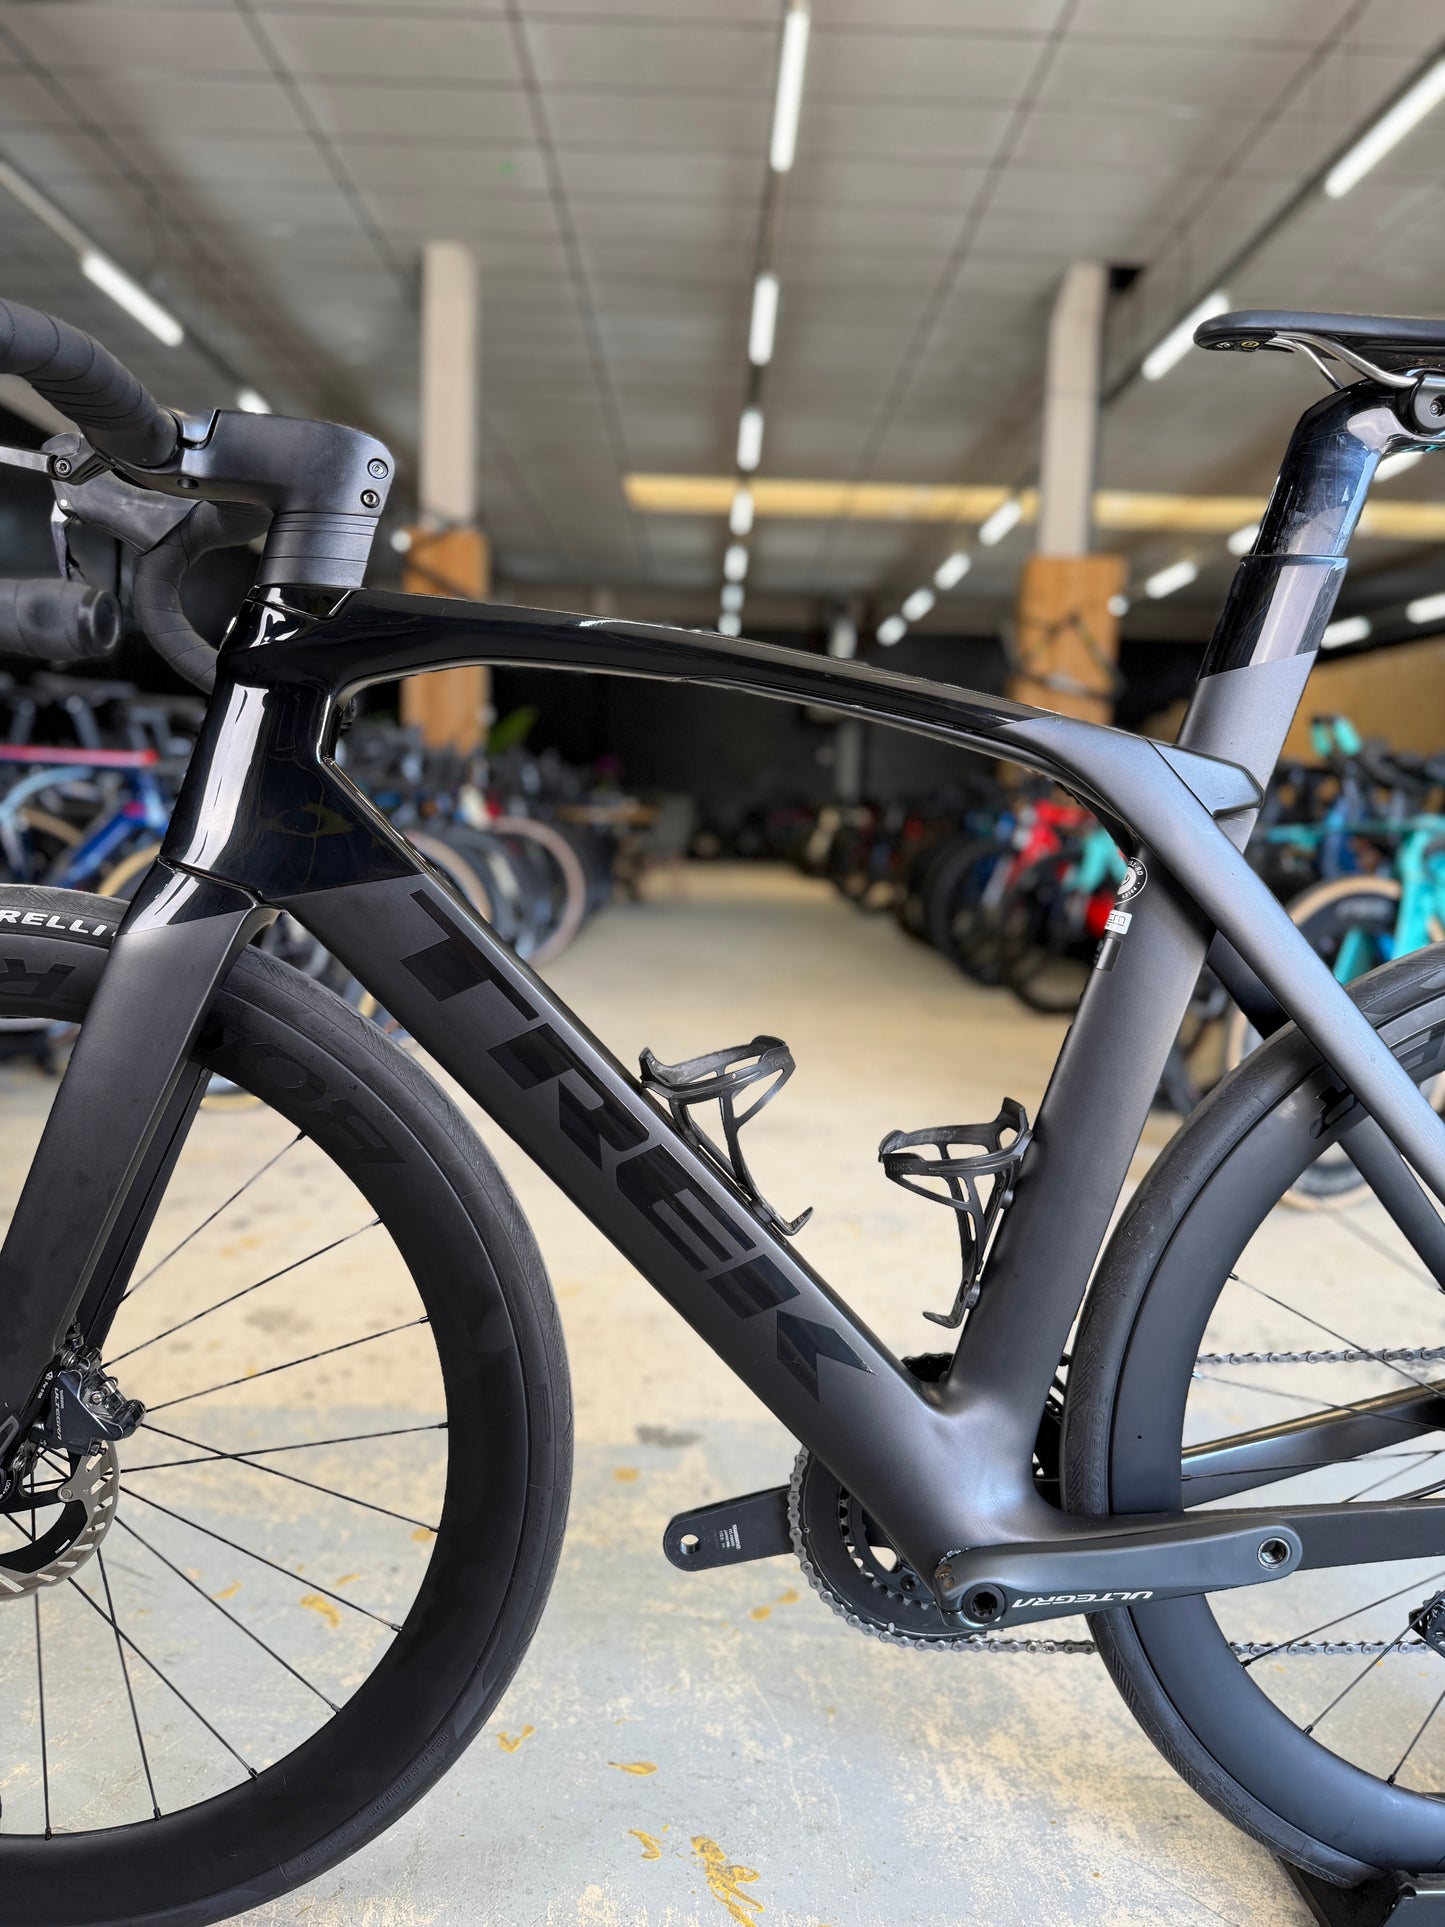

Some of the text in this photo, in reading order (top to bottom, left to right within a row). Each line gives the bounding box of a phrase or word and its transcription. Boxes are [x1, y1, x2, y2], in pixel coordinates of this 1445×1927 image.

[402, 889, 877, 1402] TREK
[54, 1387, 63, 1440] ULTEGRA
[1012, 1591, 1153, 1608] ULTEGRA
